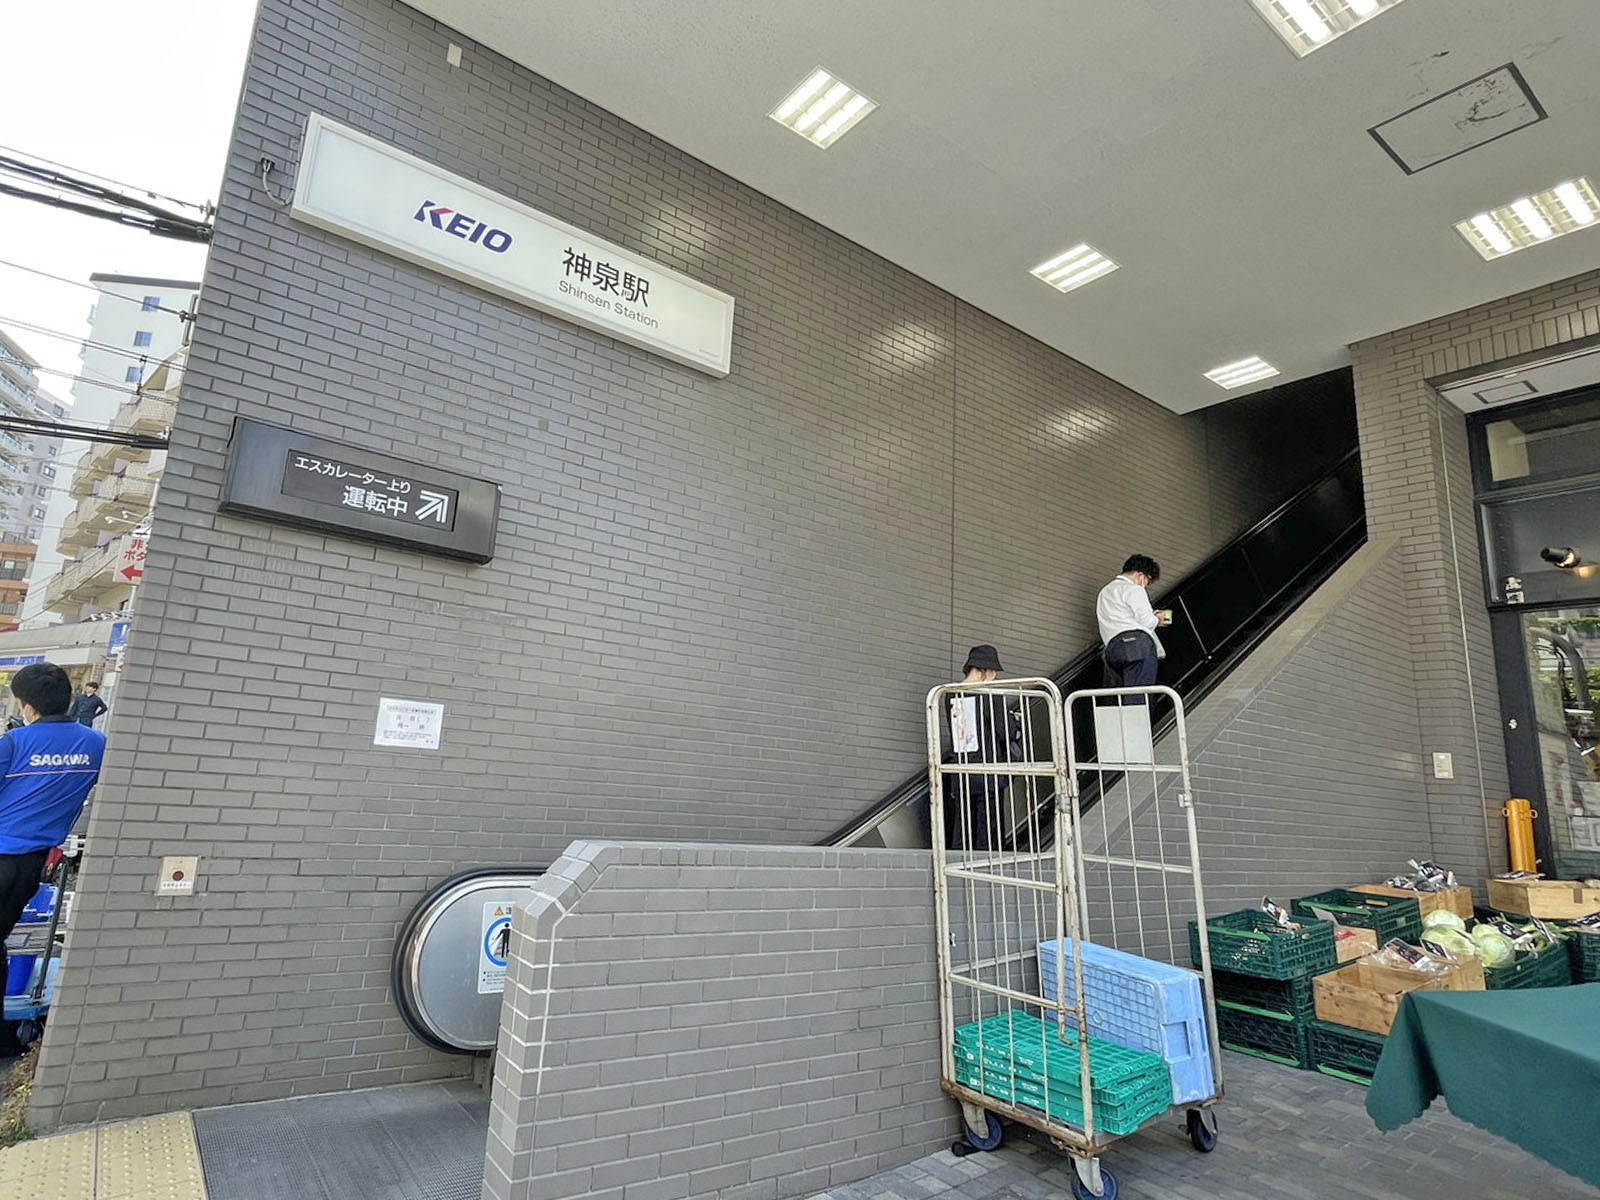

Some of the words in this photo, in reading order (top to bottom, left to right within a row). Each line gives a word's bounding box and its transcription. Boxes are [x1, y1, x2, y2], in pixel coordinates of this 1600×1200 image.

[413, 200, 513, 254] KEIO
[562, 246, 649, 308] 神泉駅
[559, 280, 611, 310] Shinsen
[614, 302, 659, 329] Station
[295, 456, 411, 494] エスカレーター上り
[342, 485, 408, 518] 運転中
[29, 753, 90, 766] SAGAWA
